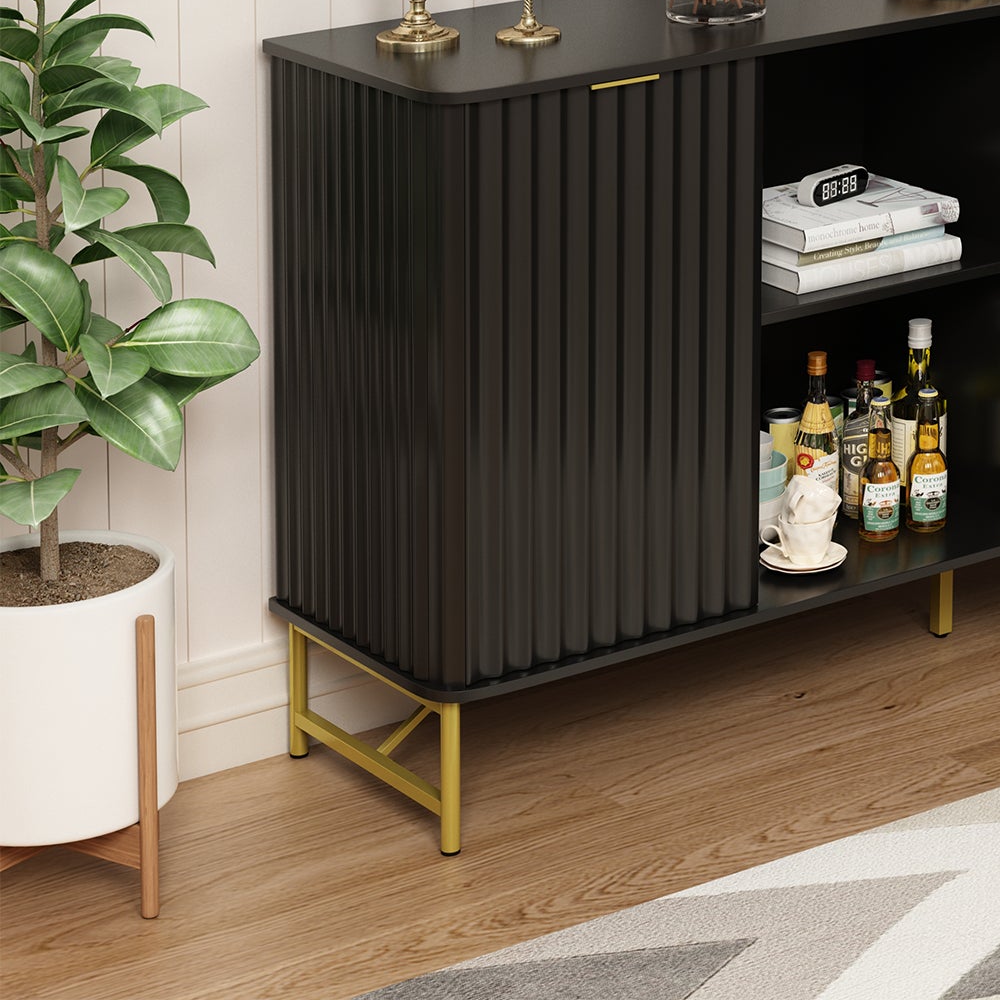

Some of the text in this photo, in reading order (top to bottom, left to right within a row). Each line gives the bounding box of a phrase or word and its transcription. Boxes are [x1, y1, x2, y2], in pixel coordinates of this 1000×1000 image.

[823, 175, 857, 200] 88:88
[808, 225, 857, 242] monochrome
[858, 222, 880, 233] home
[813, 247, 843, 261] Creating
